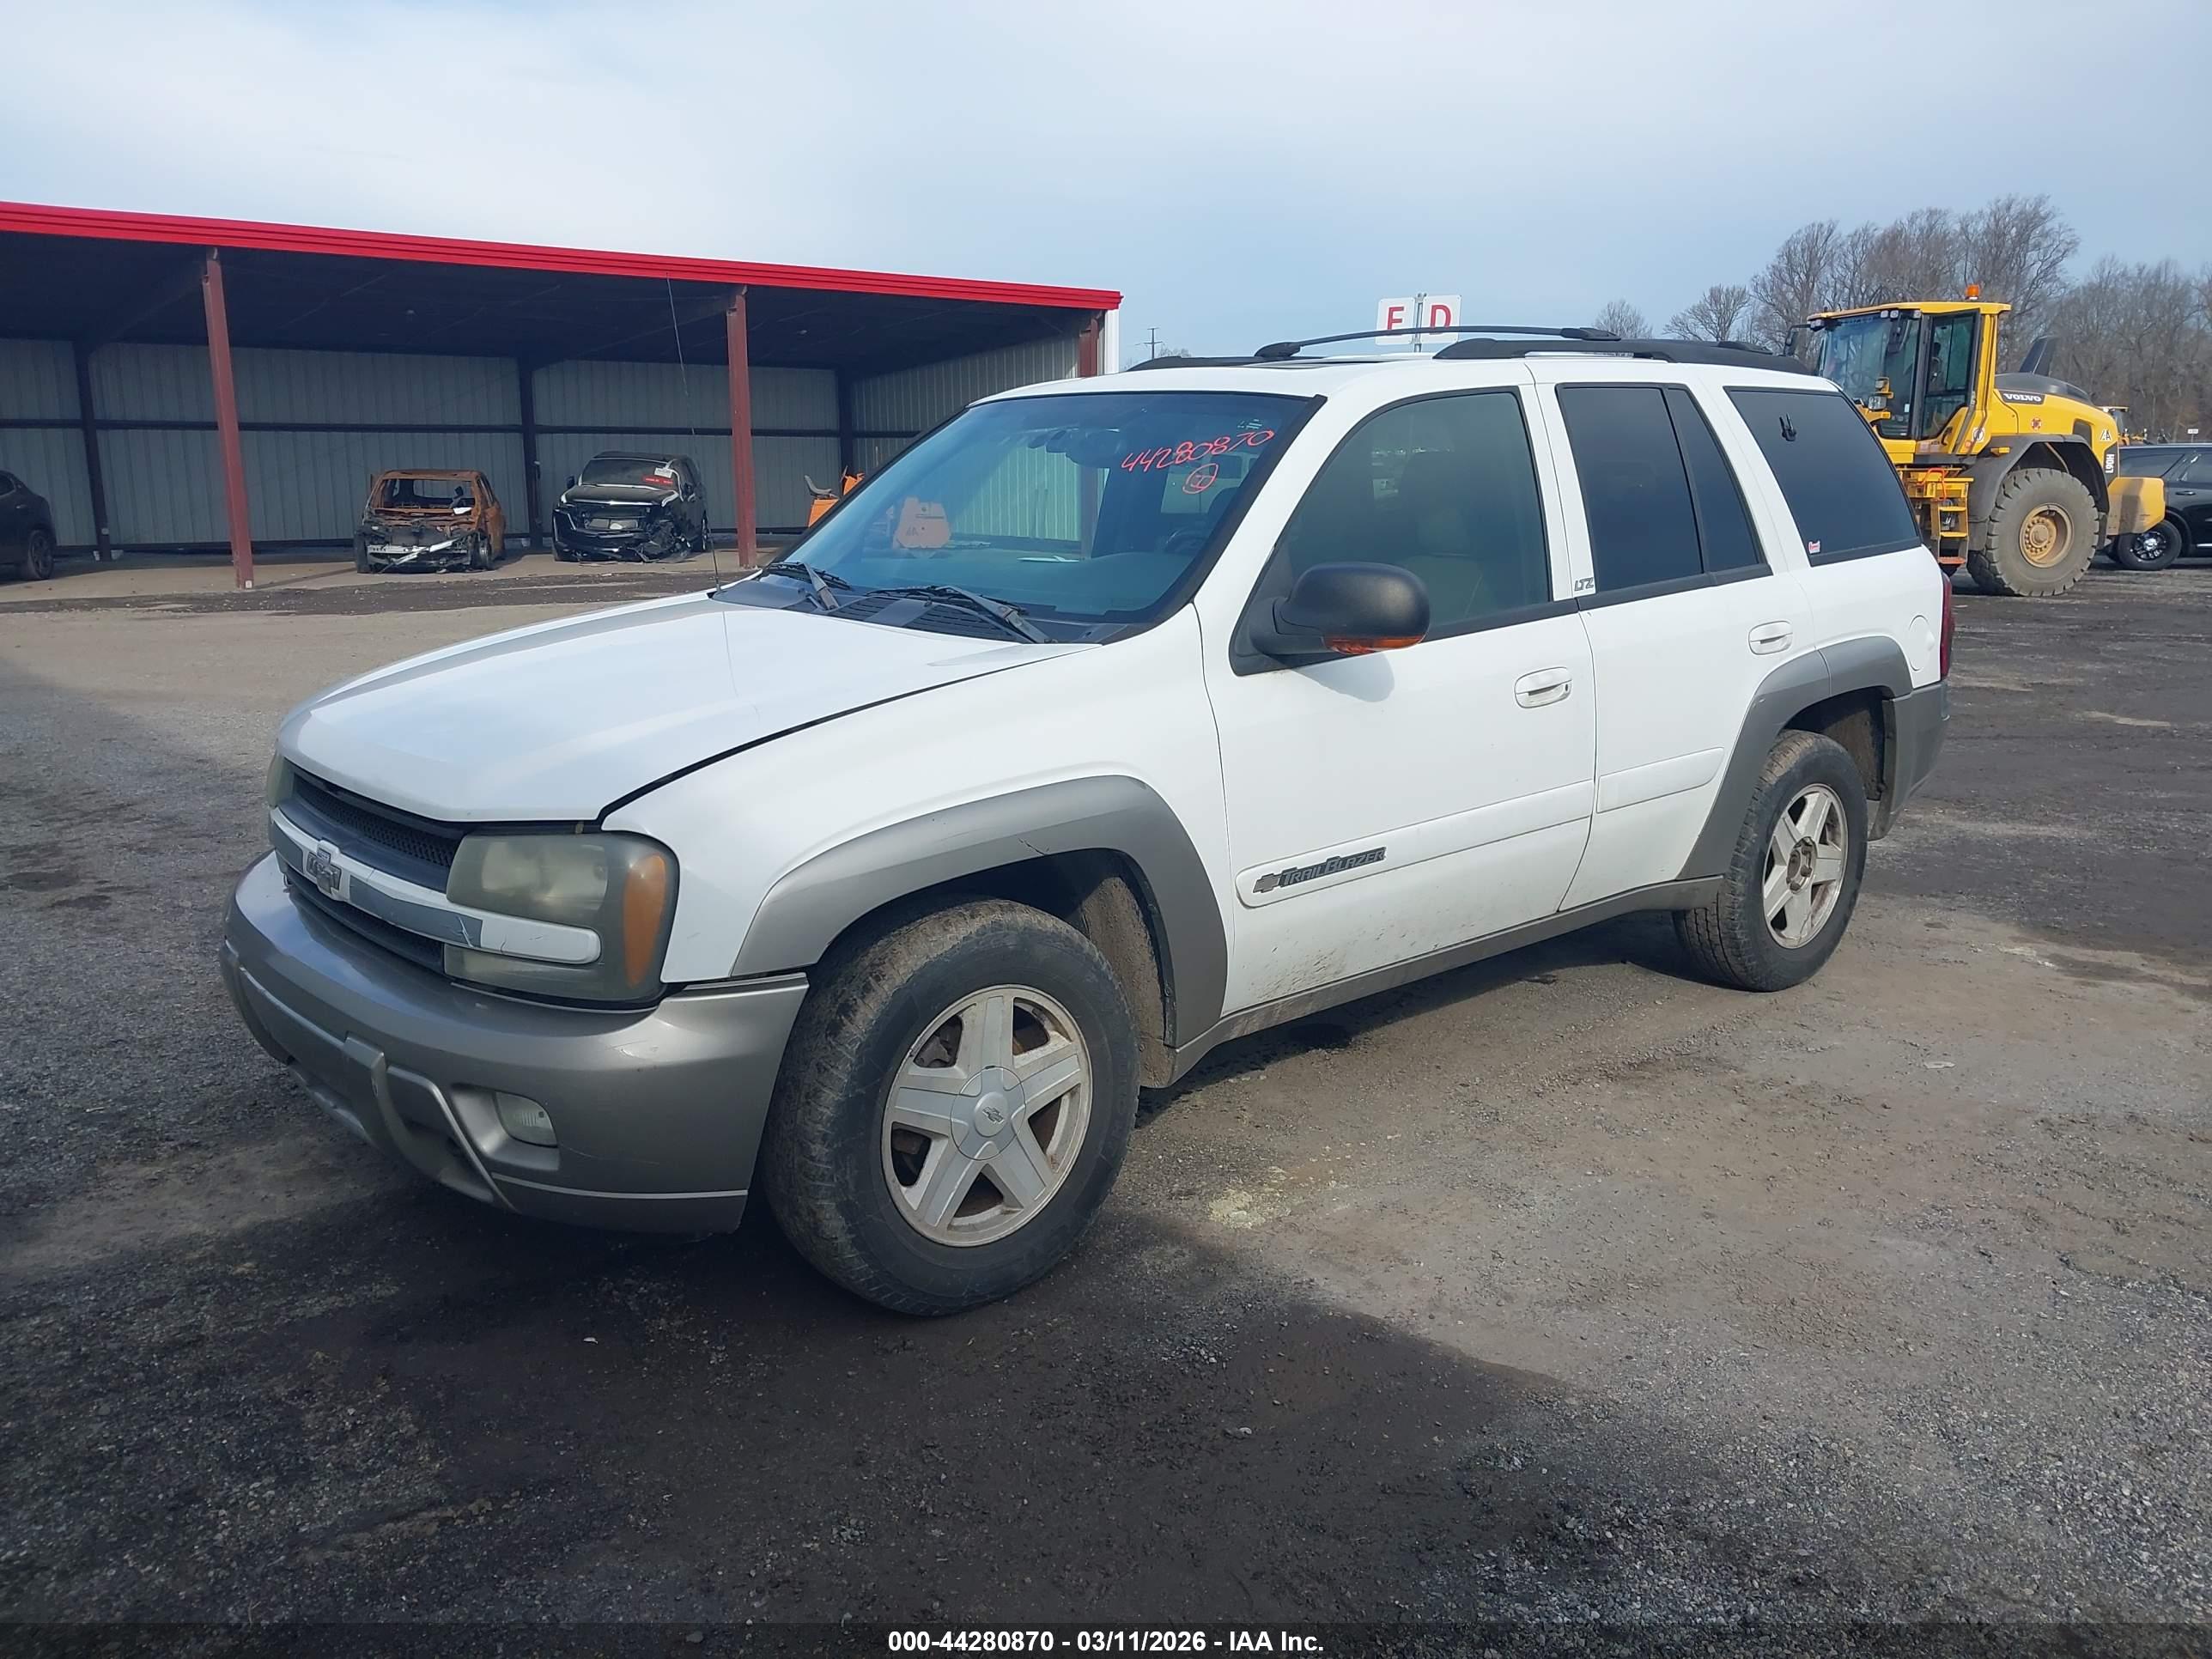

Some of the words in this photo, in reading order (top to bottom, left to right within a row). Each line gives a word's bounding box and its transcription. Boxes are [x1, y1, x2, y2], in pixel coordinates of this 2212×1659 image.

[1430, 304, 1451, 336] D
[2002, 392, 2042, 402] VOLVO
[1121, 428, 1275, 472] 44280870
[2105, 453, 2115, 474] L90H
[1574, 577, 1595, 592] LTZ
